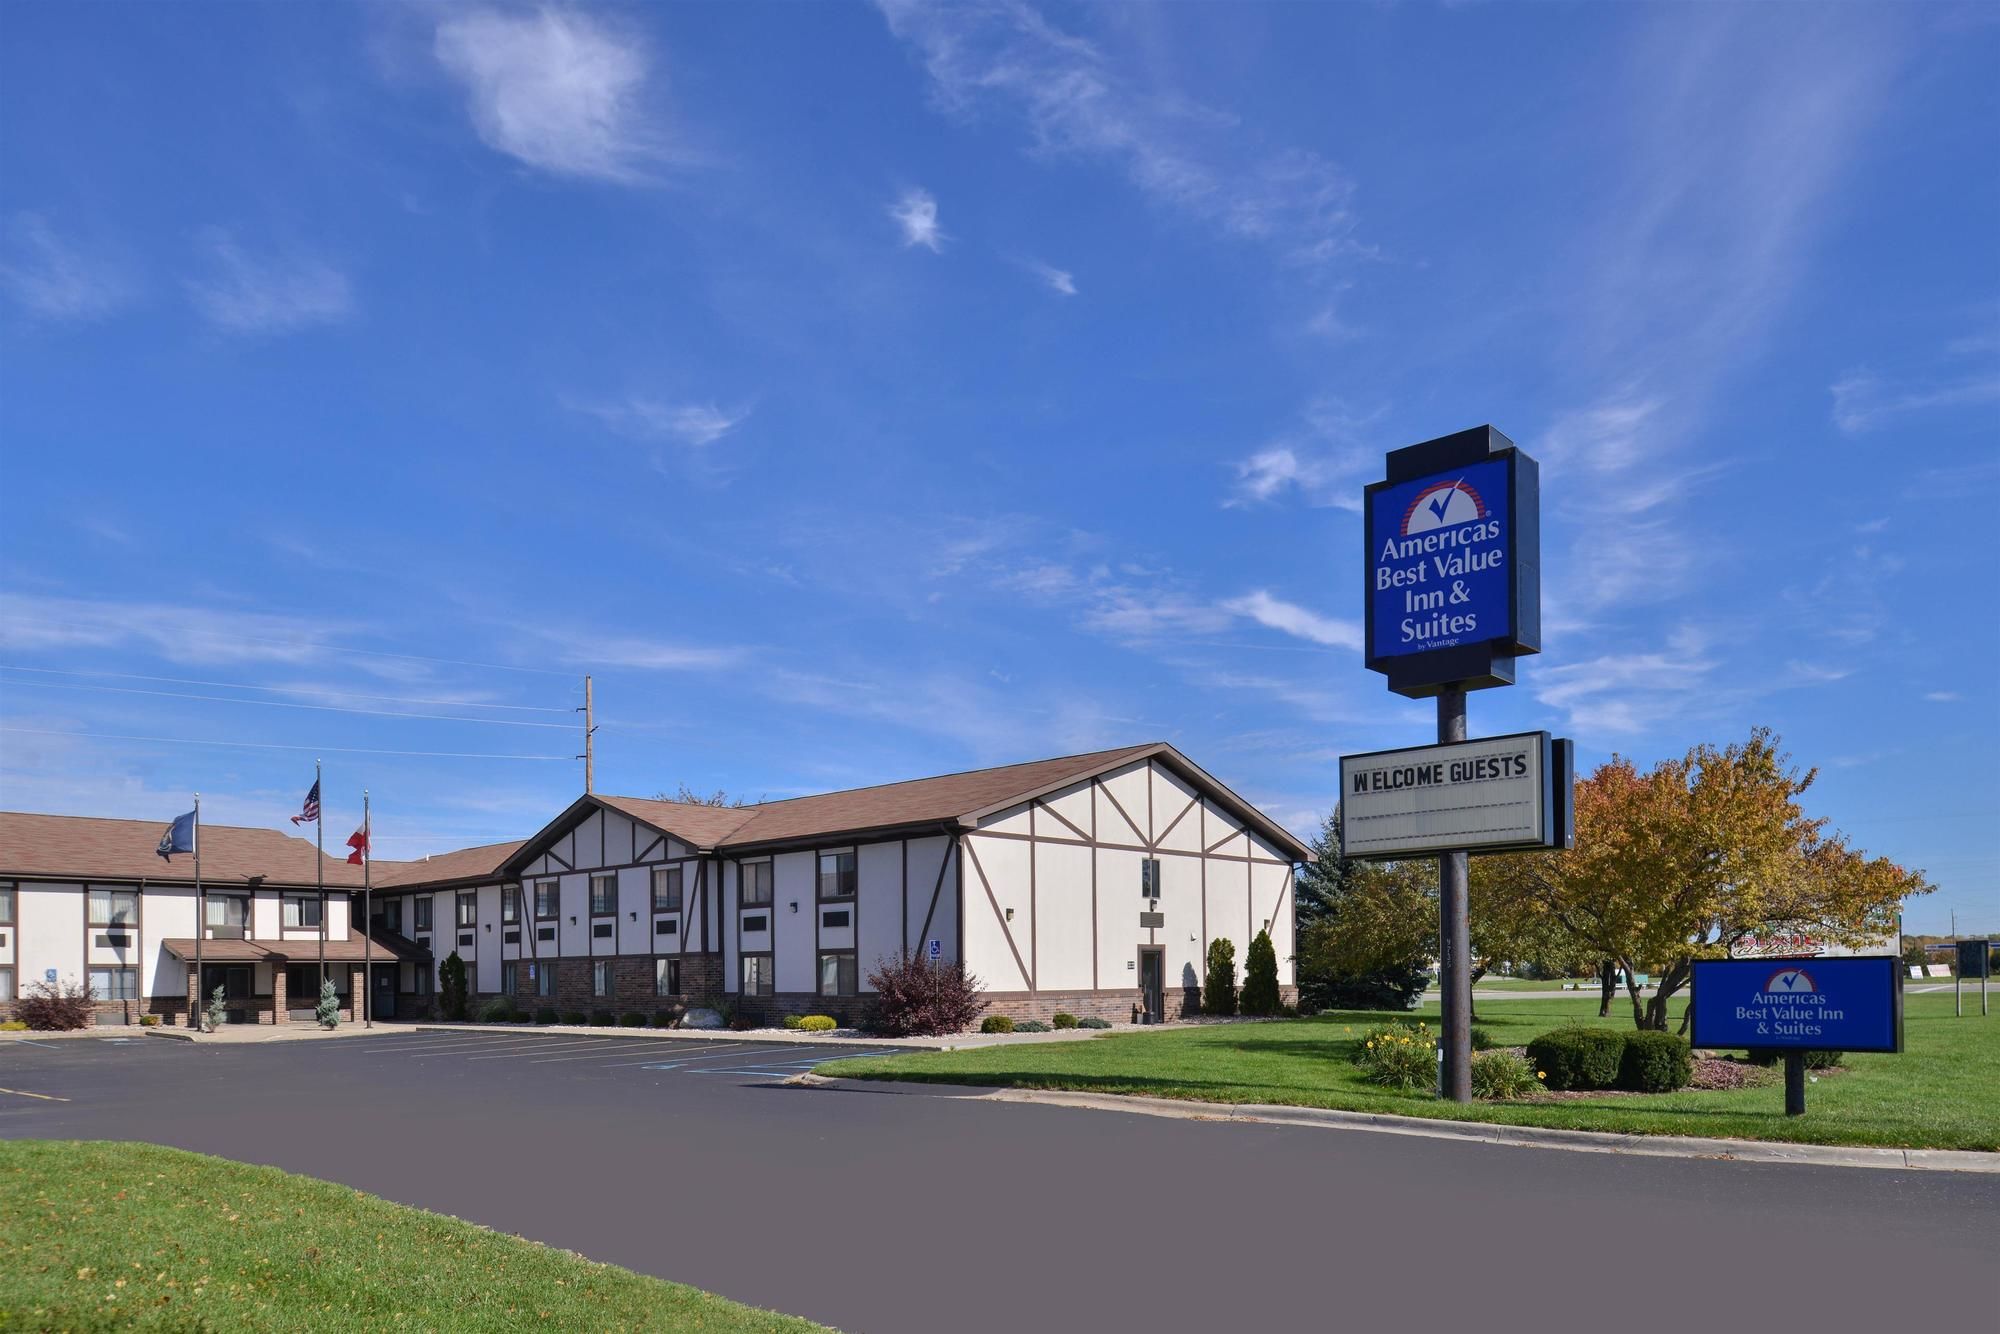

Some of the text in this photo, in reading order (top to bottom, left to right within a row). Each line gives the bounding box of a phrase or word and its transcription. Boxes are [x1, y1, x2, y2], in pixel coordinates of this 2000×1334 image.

[1380, 520, 1500, 562] Americas
[1376, 547, 1503, 590] Best Value
[1406, 580, 1471, 613] Inn &
[1401, 612, 1477, 642] Suites
[1417, 638, 1460, 651] by Vantage
[1354, 754, 1527, 793] WELCOME GUESTS
[1736, 1006, 1844, 1020] Best Value Inn
[1752, 991, 1826, 1005] Americas
[1756, 1021, 1822, 1035] & Suites
